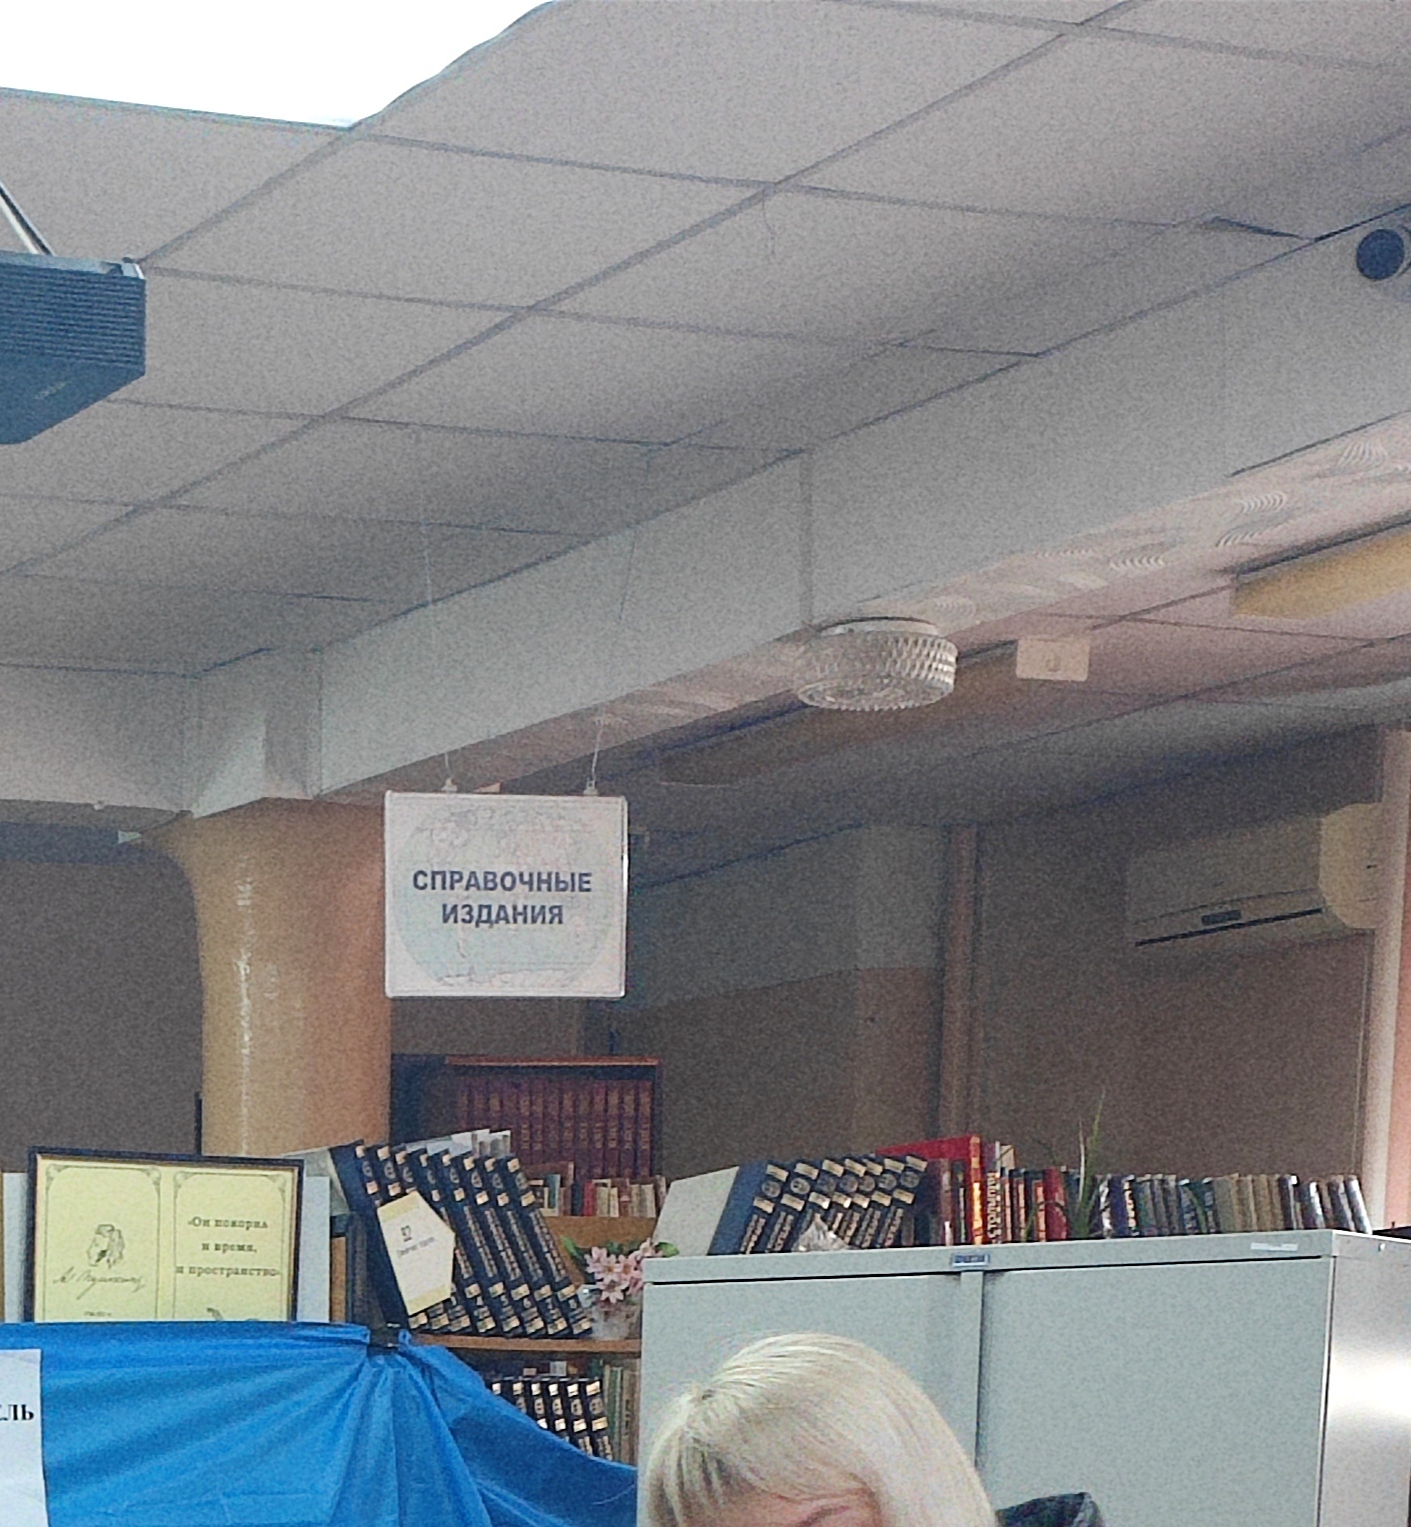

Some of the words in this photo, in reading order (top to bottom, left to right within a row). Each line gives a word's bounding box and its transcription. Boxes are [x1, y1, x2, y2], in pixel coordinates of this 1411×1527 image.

[413, 869, 593, 893] СПРАВОЧНЫЕ
[441, 903, 564, 928] ИЗДАНИЯ
[214, 1219, 269, 1231] покорил
